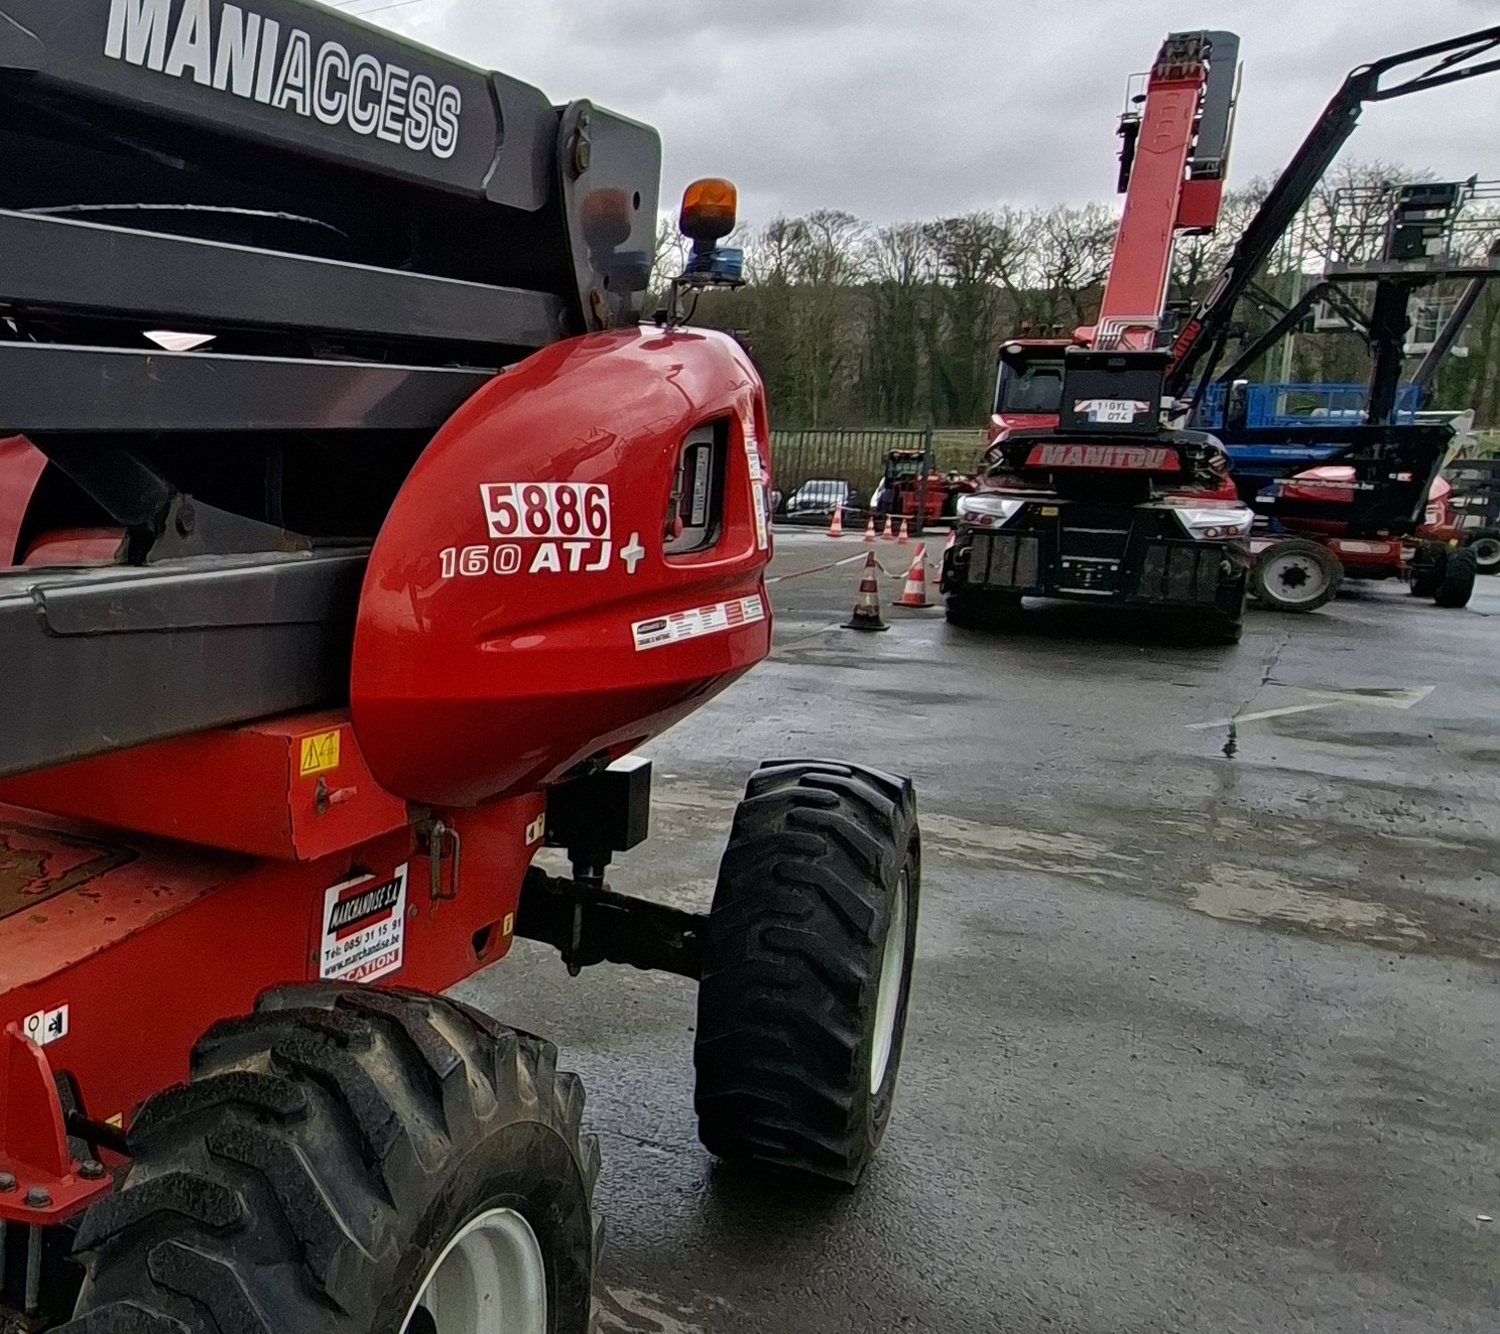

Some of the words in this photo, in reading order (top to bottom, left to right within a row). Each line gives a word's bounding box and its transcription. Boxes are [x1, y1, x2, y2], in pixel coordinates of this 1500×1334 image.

[1041, 444, 1167, 468] MANITOU
[488, 485, 607, 536] 5886
[440, 543, 522, 578] 160
